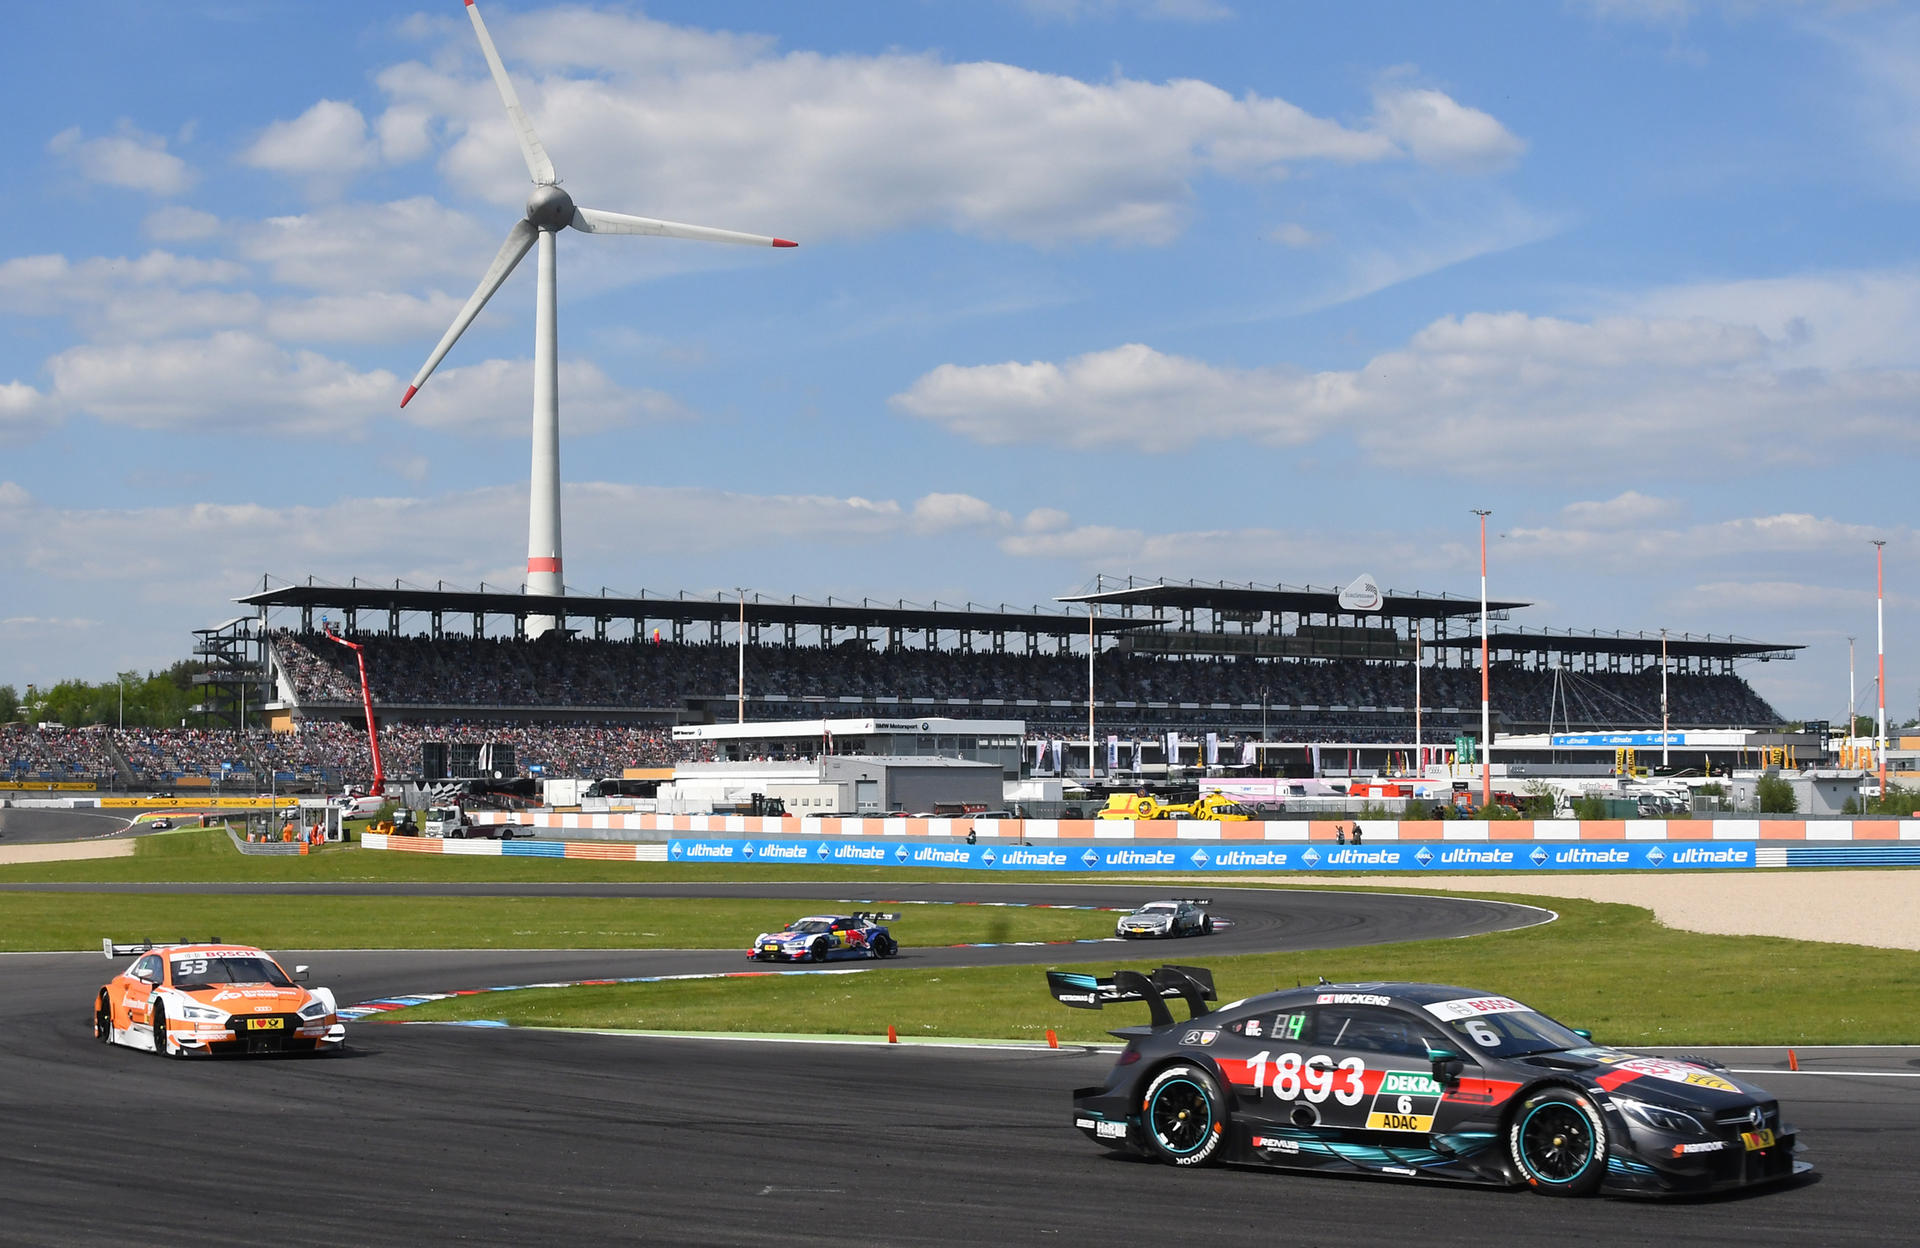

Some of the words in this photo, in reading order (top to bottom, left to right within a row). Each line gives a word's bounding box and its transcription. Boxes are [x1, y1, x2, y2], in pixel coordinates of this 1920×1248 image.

[687, 844, 733, 857] ultimate
[759, 844, 807, 858] ultimate
[835, 845, 885, 860] ultimate
[914, 848, 970, 863] ultimate
[1002, 851, 1067, 865] ultimate
[1106, 850, 1175, 865] ultimate
[1215, 851, 1287, 865] ultimate
[1327, 850, 1400, 864] ultimate
[1441, 849, 1514, 863] ultimate
[1556, 848, 1629, 863] ultimate
[1672, 848, 1748, 863] ultimate
[178, 960, 209, 976] 53
[1333, 995, 1391, 1007] WICKENS
[1464, 1020, 1502, 1047] 6
[1246, 1051, 1365, 1106] 1893
[1386, 1075, 1441, 1093] DEKRA
[1397, 1095, 1412, 1114] 6
[1383, 1115, 1418, 1130] ADAC
[1259, 1138, 1299, 1150] REMUS
